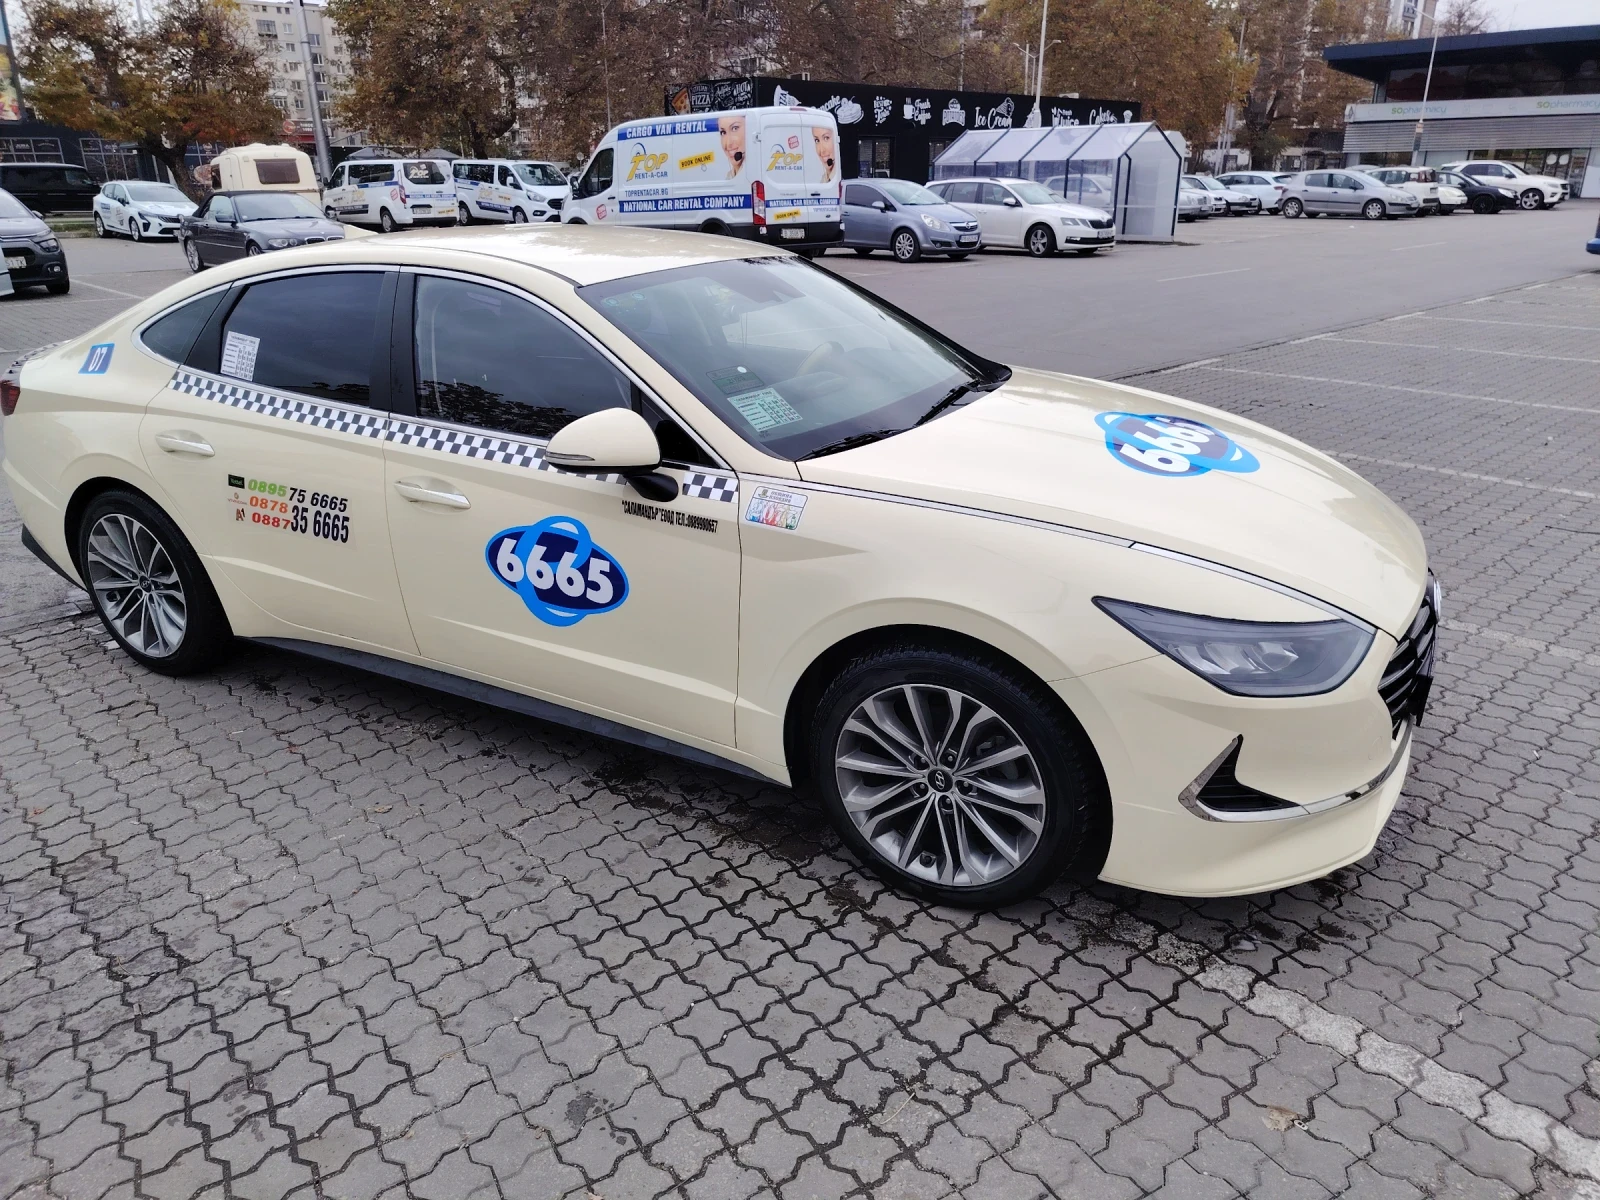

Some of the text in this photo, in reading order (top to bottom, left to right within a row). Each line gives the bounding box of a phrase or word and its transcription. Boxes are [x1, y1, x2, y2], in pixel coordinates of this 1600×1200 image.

[692, 95, 711, 105] PIZZA
[974, 106, 1013, 129] Ice Cream
[626, 120, 707, 138] CARGO VAN RENTAL
[626, 153, 668, 182] TOP
[681, 155, 711, 168] BOOK ONLINE
[766, 152, 803, 171] TOP
[635, 171, 668, 180] RENT-A-CAR
[625, 188, 669, 198] TOPRENTACAR.BG
[623, 196, 744, 213] NATIONAL CAR RENTAL COMPANY
[88, 347, 108, 372] 07
[248, 479, 287, 497] 0895
[289, 487, 307, 504] 75
[310, 492, 348, 512] 6665
[249, 496, 288, 514] 0878
[252, 512, 291, 530] 0887
[291, 505, 309, 534] 35
[313, 510, 350, 543] 6665
[496, 537, 614, 604] 6665
